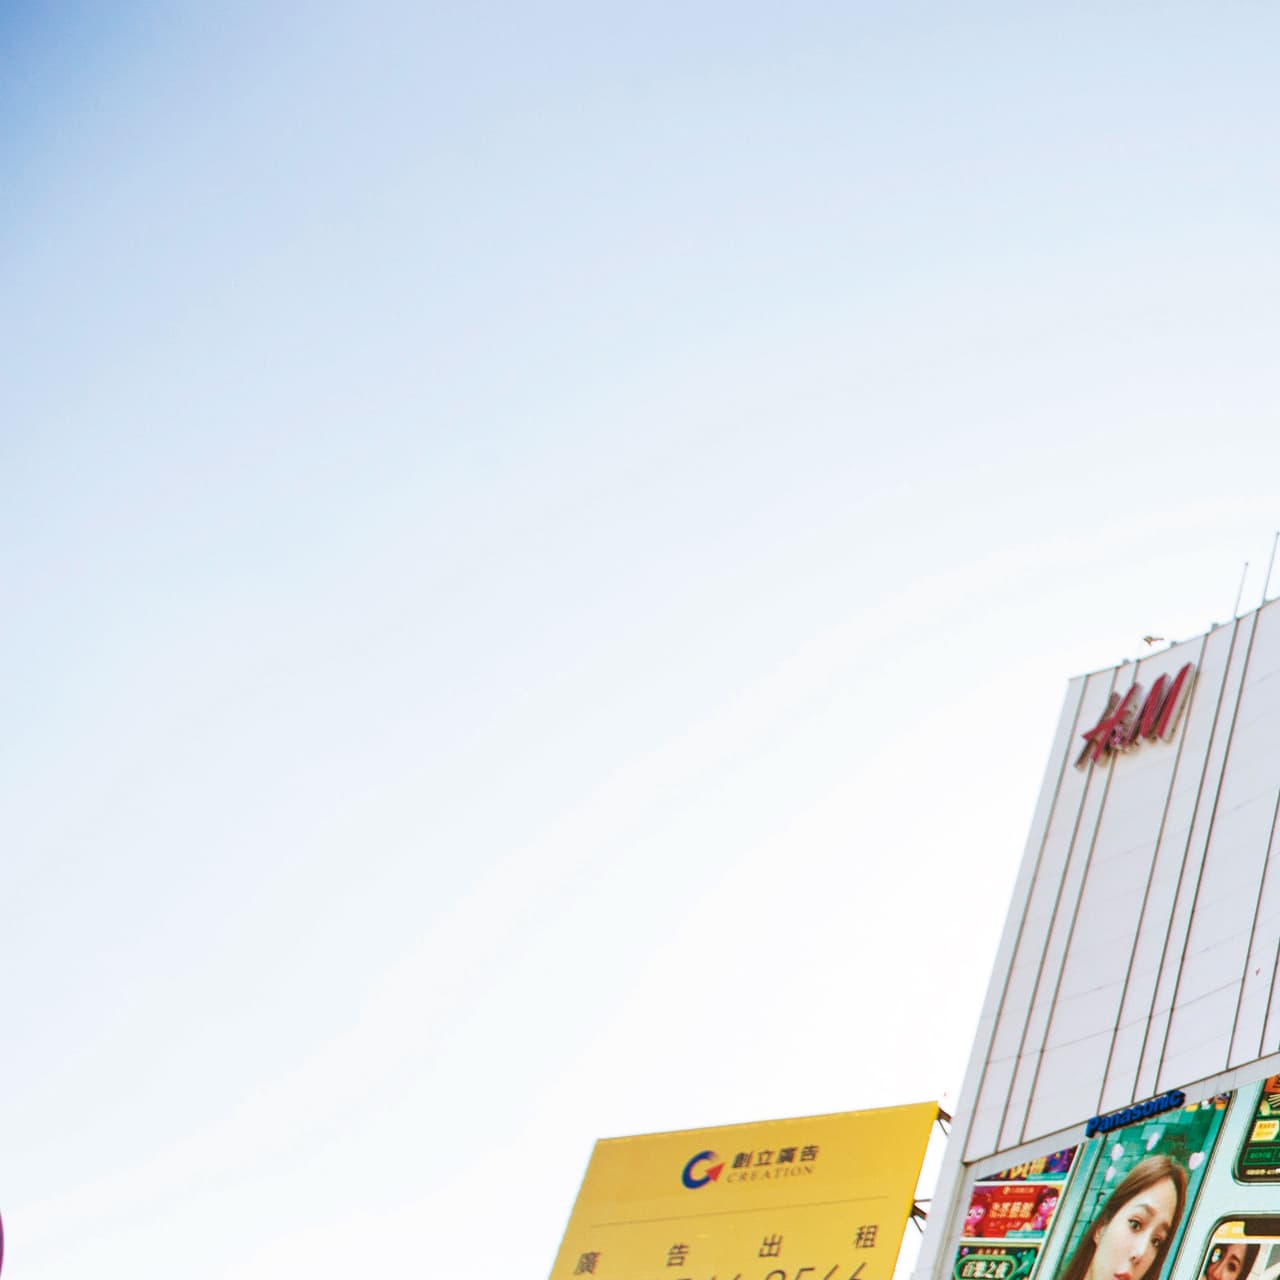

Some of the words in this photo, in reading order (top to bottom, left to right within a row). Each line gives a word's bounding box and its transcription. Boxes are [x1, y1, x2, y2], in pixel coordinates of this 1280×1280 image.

[1085, 1089, 1186, 1137] Panasonic
[731, 1145, 820, 1169] 創立廣告
[727, 1165, 815, 1184] CREATION
